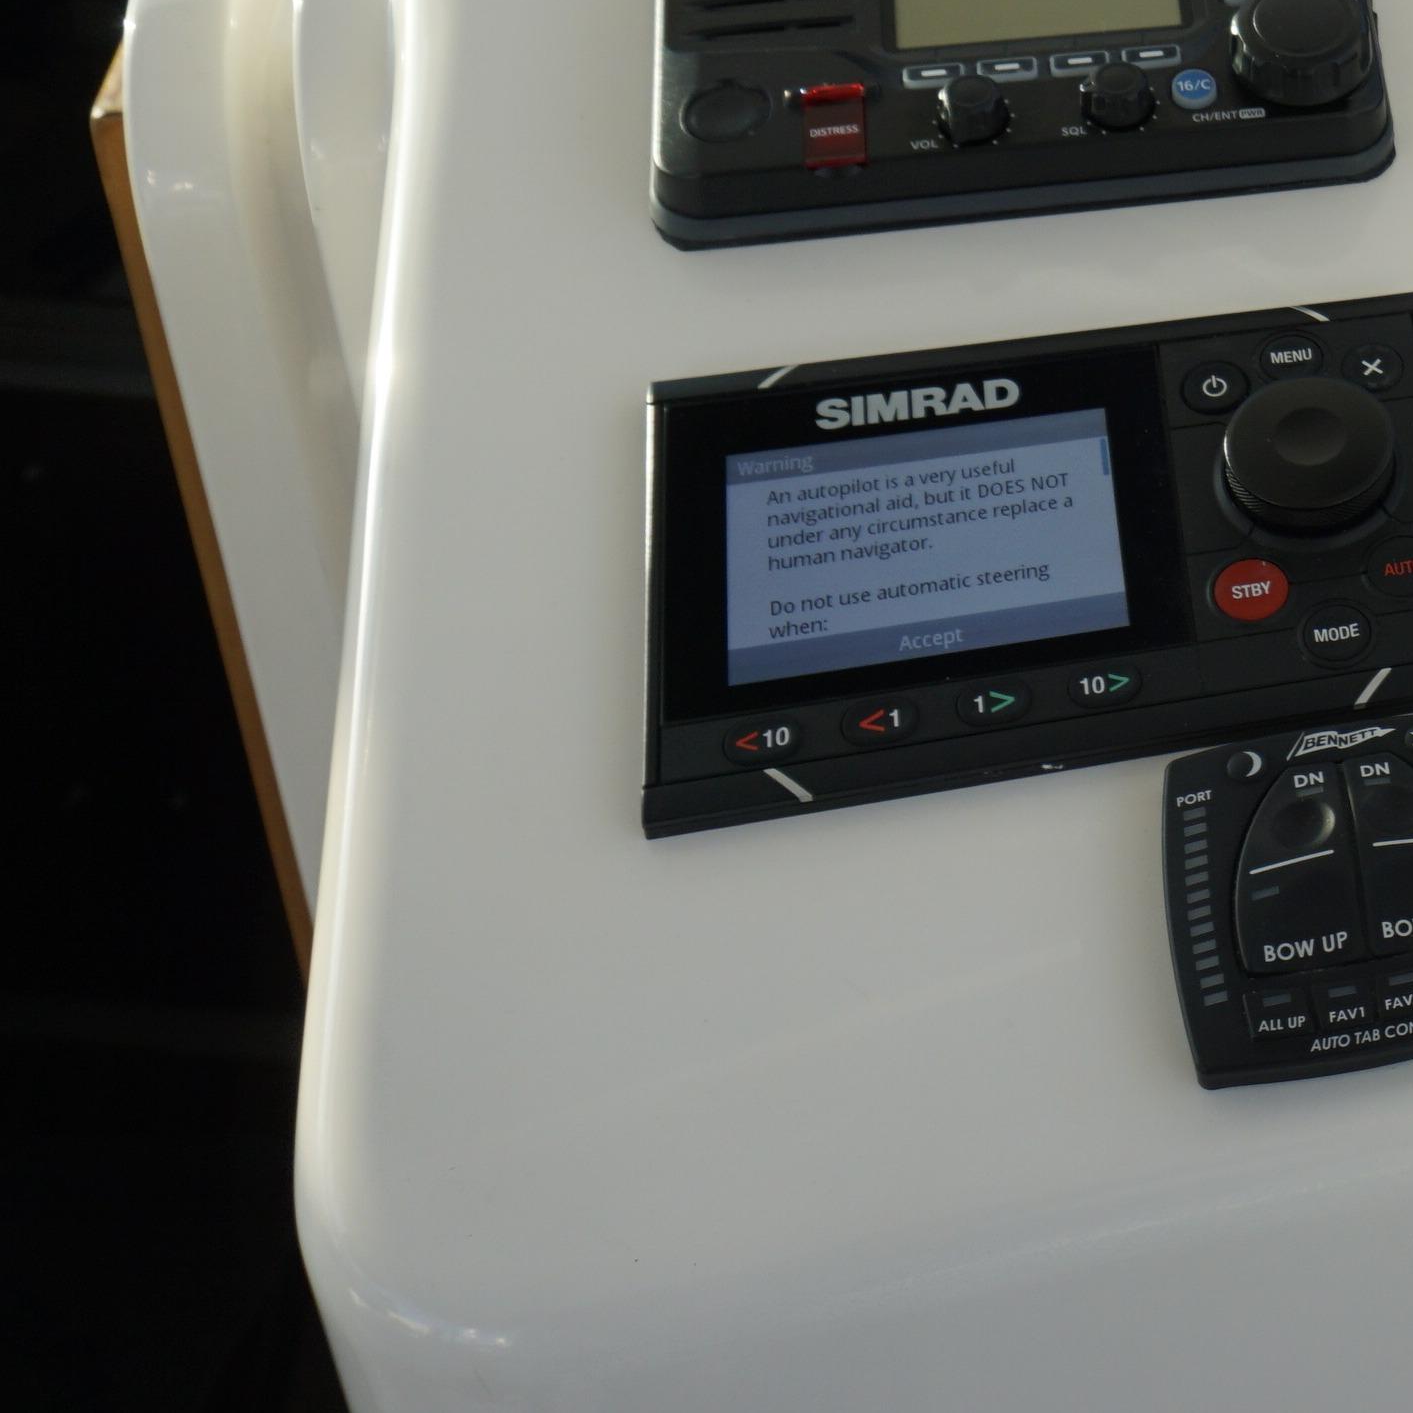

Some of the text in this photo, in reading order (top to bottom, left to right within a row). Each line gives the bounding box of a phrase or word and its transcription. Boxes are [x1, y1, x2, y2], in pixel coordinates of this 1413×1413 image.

[1177, 78, 1211, 92] 16/C
[1192, 108, 1265, 122] CH/ENT PWR
[809, 123, 859, 137] DISTRESS
[1061, 125, 1087, 137] SQL
[910, 139, 938, 151] VOL
[1270, 348, 1312, 364] MENU
[815, 378, 1021, 430] SIMRAD
[737, 453, 814, 477] Warning
[767, 458, 1015, 506] An autopilot is a very useful
[767, 473, 1069, 530] navigational aid, but it DOES NOT
[767, 496, 1074, 550] under any circumstance replace a
[768, 535, 933, 572] human navigator.
[769, 562, 1051, 617] Do not use automatic steering
[1231, 581, 1271, 600] STBY
[769, 617, 829, 640] when:
[1313, 623, 1360, 643] MODE
[899, 628, 964, 652] Accept
[1304, 727, 1379, 752] BENNETT
[1293, 770, 1324, 788] DN
[1359, 761, 1390, 778] DN
[1176, 789, 1212, 807] PORT
[1263, 931, 1348, 963] BOW UP
[1258, 1015, 1306, 1033] ALL UP
[1329, 1006, 1366, 1023] FAV1
[1310, 1033, 1351, 1052] AUTO
[1354, 1028, 1381, 1045] TAB
